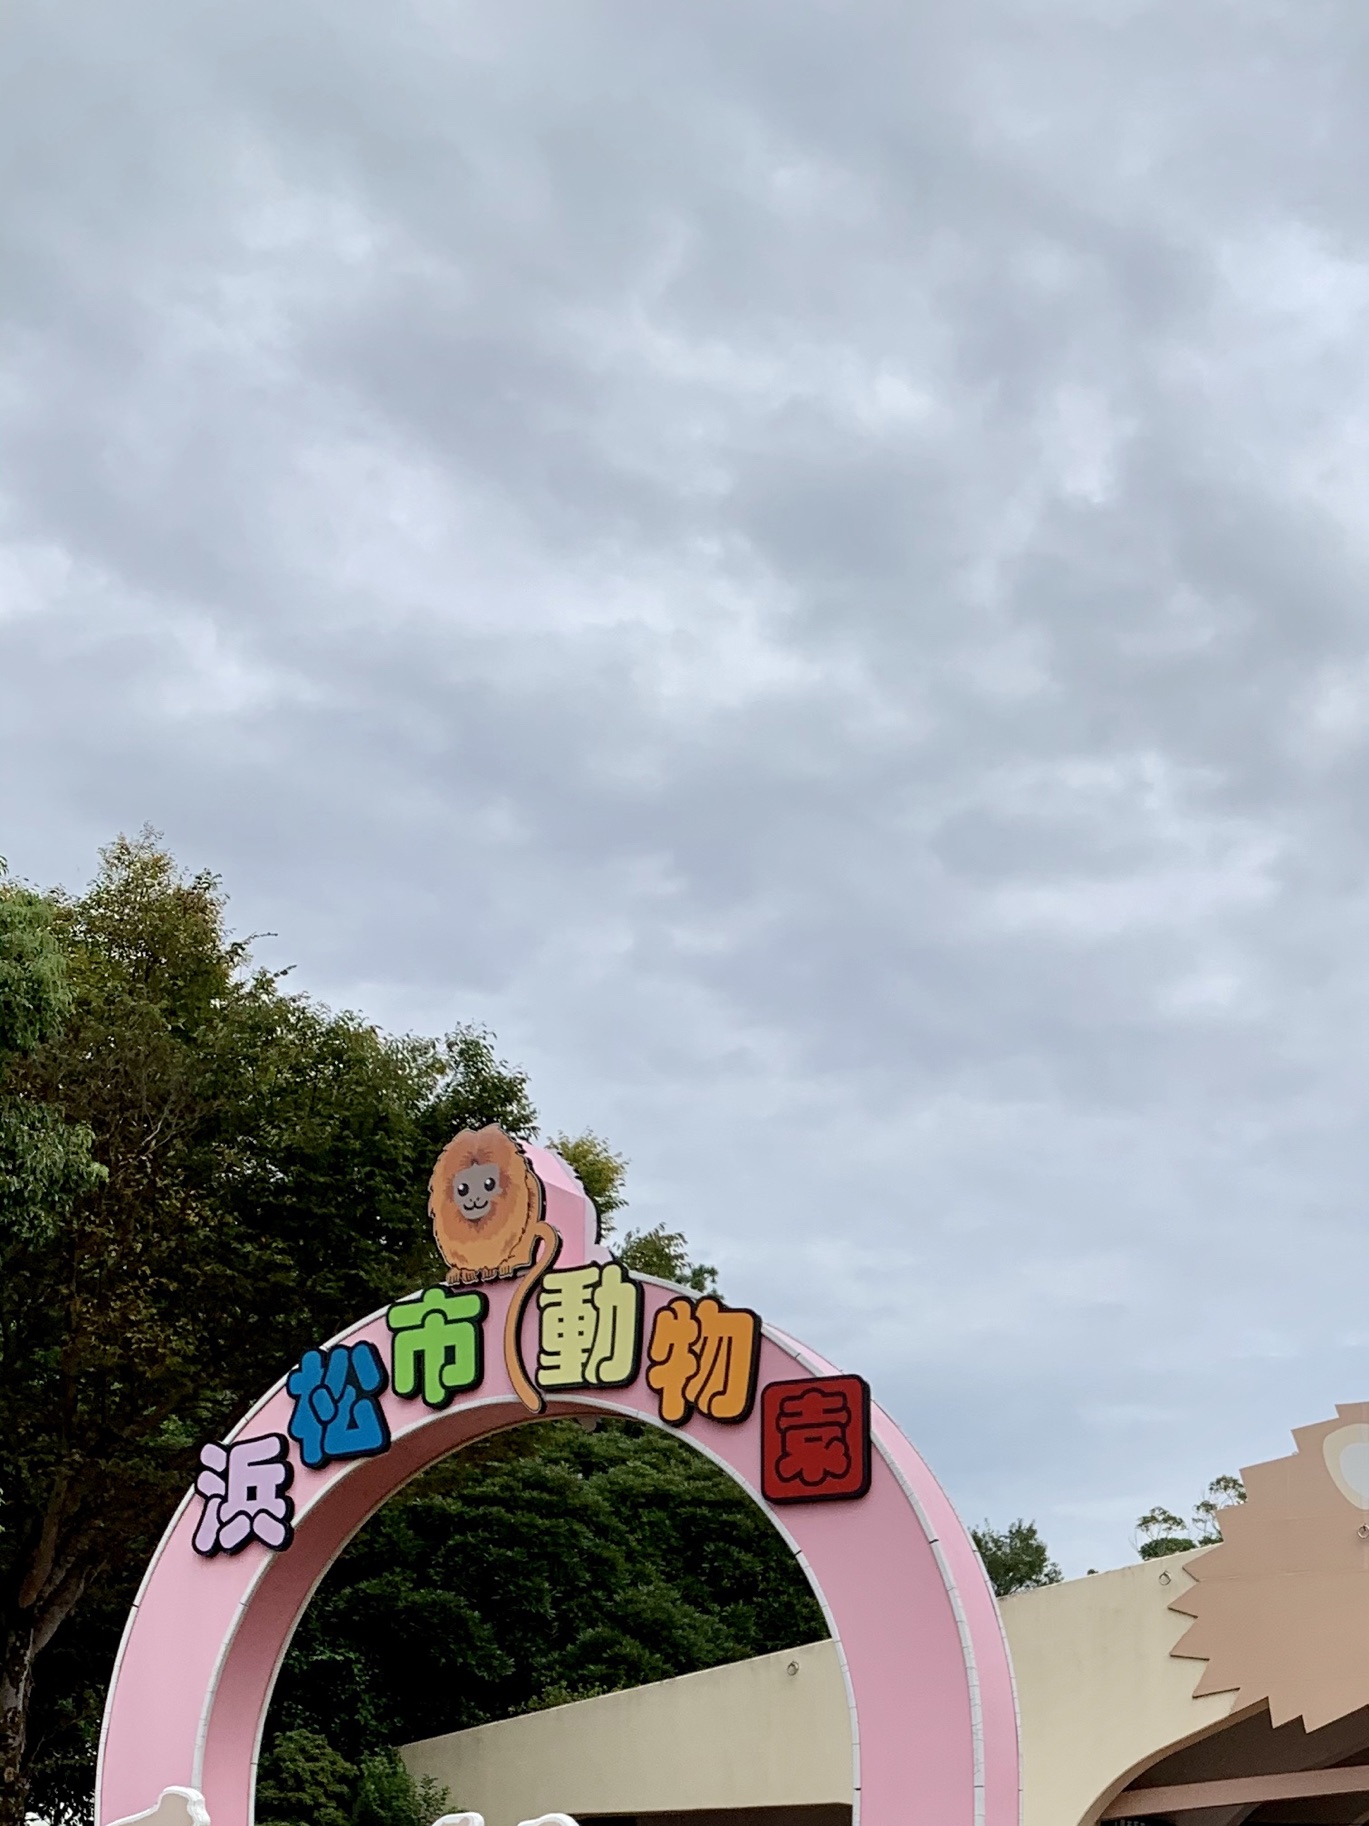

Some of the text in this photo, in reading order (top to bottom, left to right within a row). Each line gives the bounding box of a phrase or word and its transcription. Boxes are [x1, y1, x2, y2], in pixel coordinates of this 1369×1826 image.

[193, 1261, 872, 1557] 浜松市動物園
